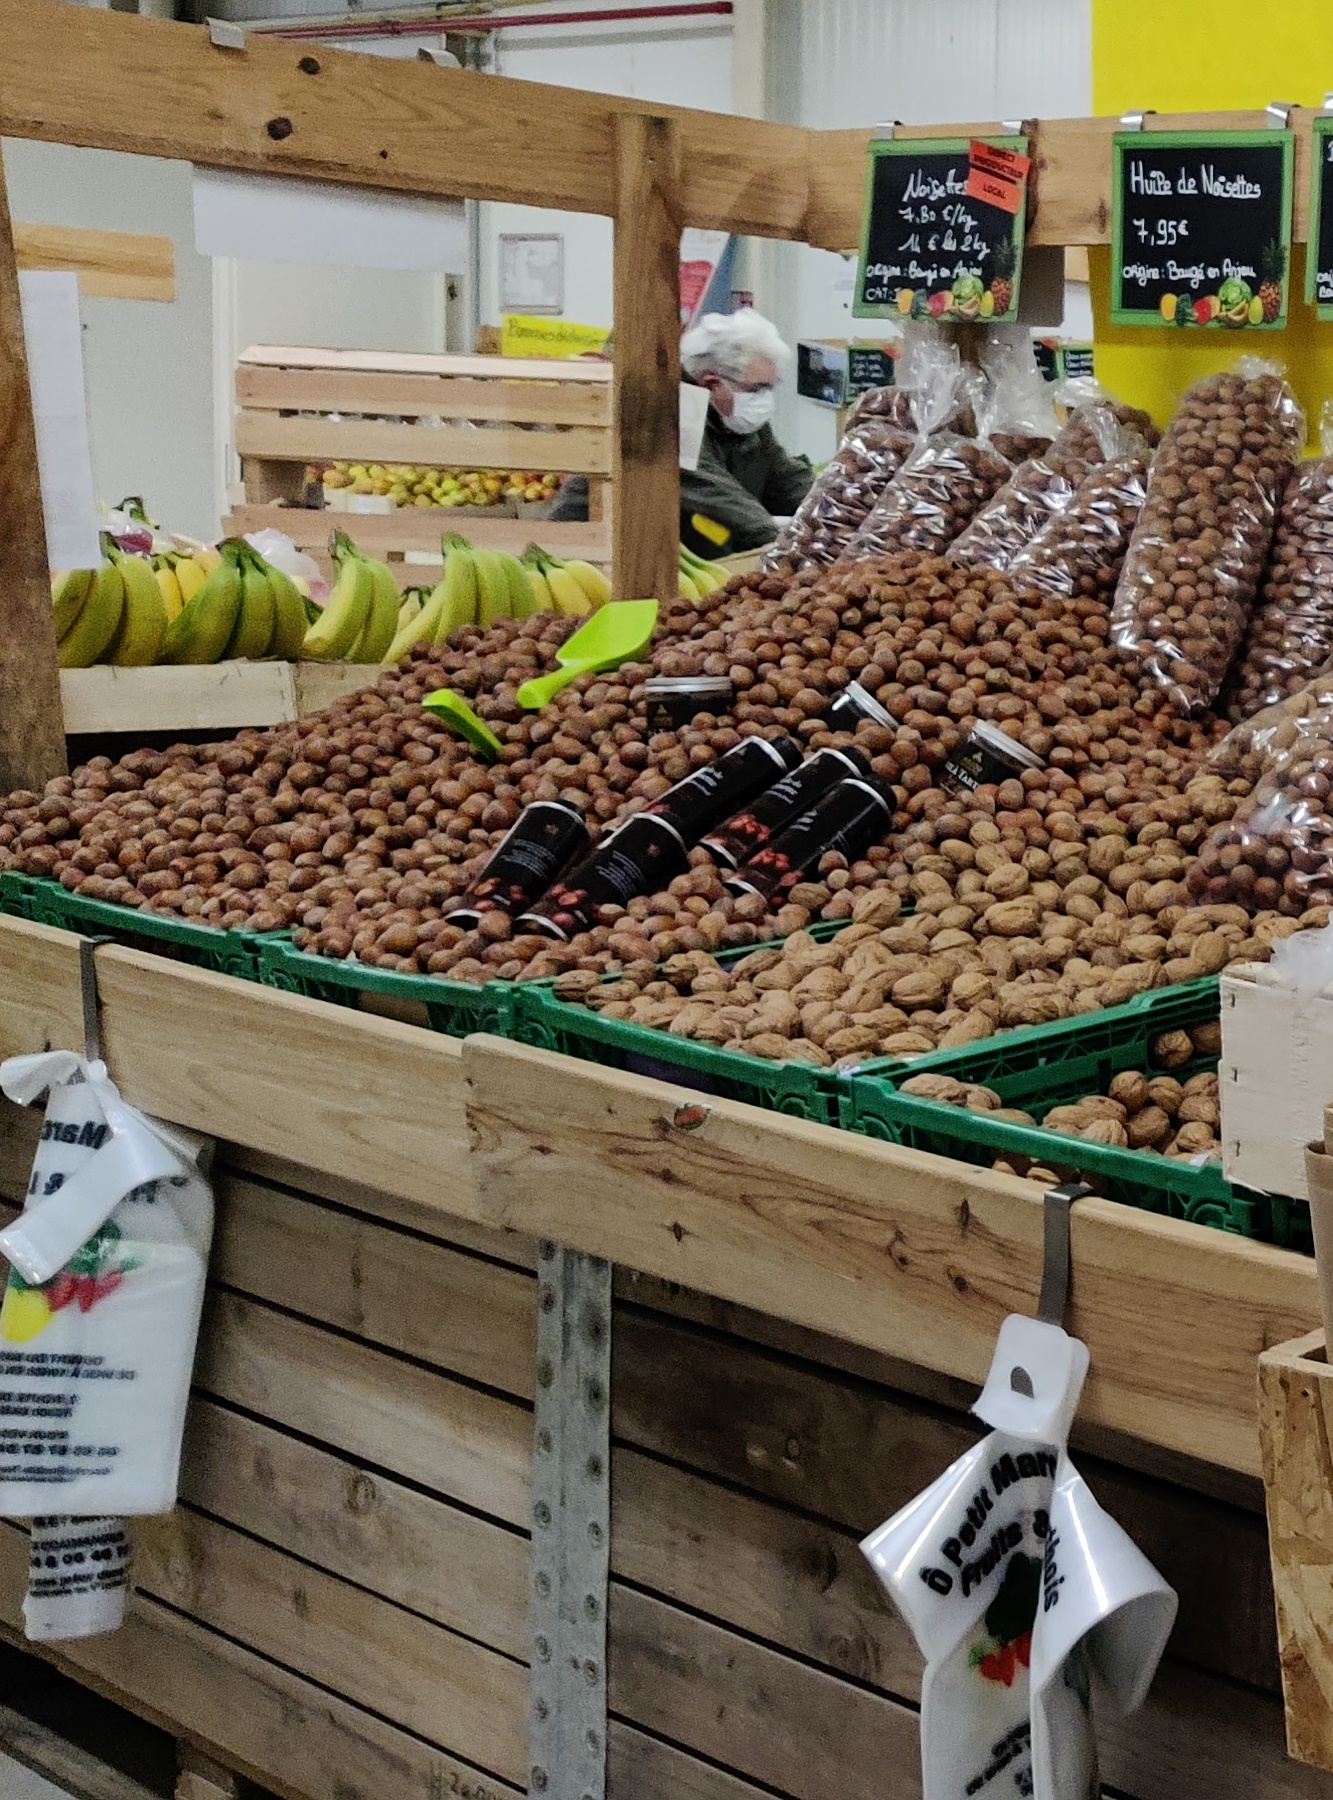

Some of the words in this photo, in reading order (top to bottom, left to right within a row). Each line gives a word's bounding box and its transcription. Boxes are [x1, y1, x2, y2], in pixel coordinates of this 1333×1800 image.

[974, 154, 1023, 178] PRODUCTEUR
[983, 184, 1006, 199] LOCAL
[1131, 161, 1172, 195] Huile
[1178, 167, 1198, 194] de
[1202, 164, 1261, 198] Noisettes
[1208, 266, 1220, 278] en
[1223, 258, 1256, 282] Anjou
[940, 1486, 994, 1567] Petit
